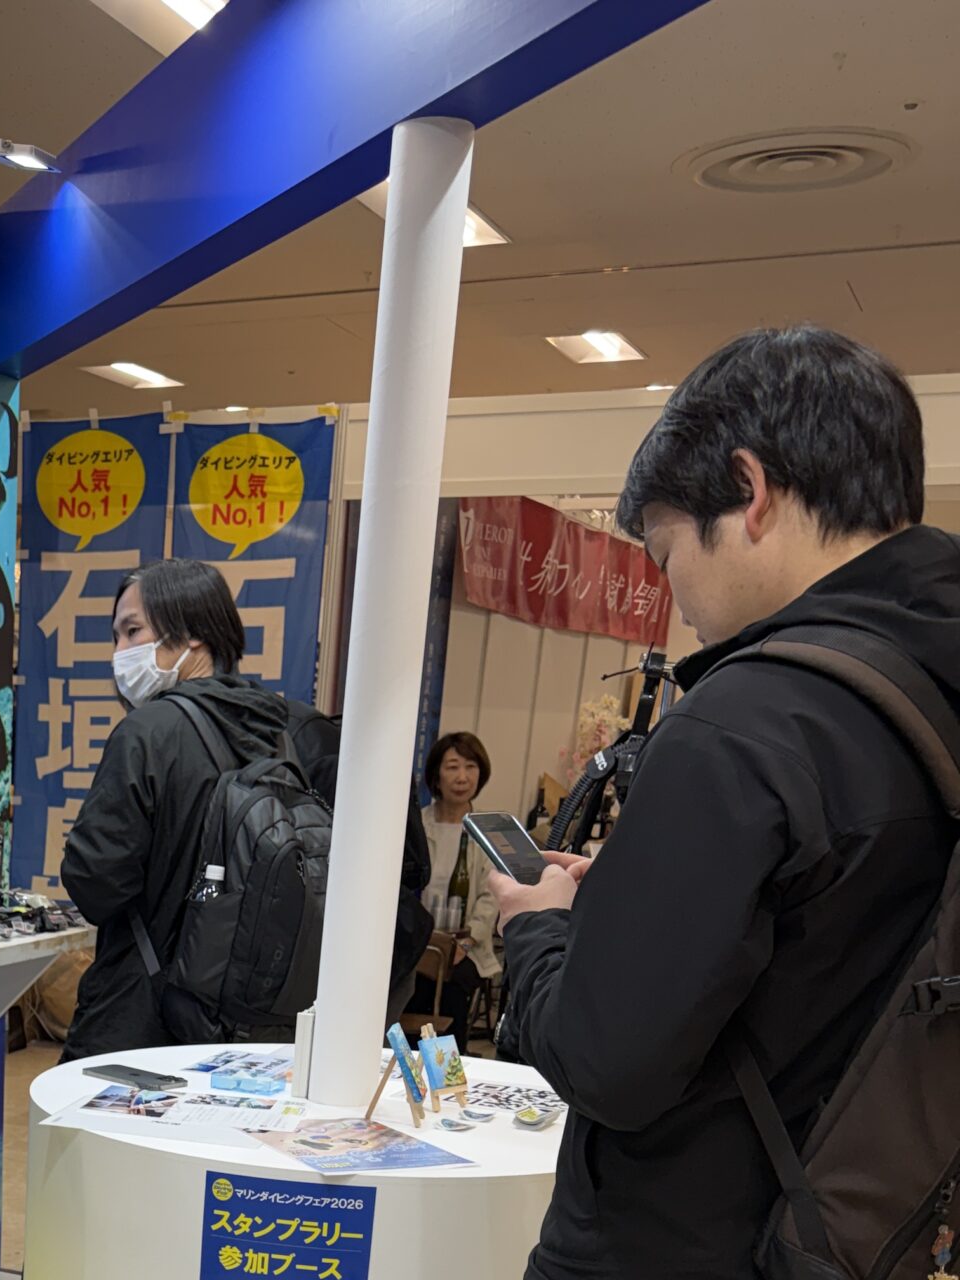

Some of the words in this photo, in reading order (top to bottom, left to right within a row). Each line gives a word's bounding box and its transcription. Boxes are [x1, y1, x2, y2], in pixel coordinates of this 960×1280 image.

[45, 448, 135, 465] ダイビングエリア
[199, 455, 297, 471] ダイビングエリア
[68, 468, 111, 493] 人気
[224, 473, 268, 500] 人気
[234, 1188, 364, 1210] マリンダイビングフェア2026
[211, 1209, 364, 1246] スタンプラリー
[218, 1245, 342, 1280] 参加ブース
